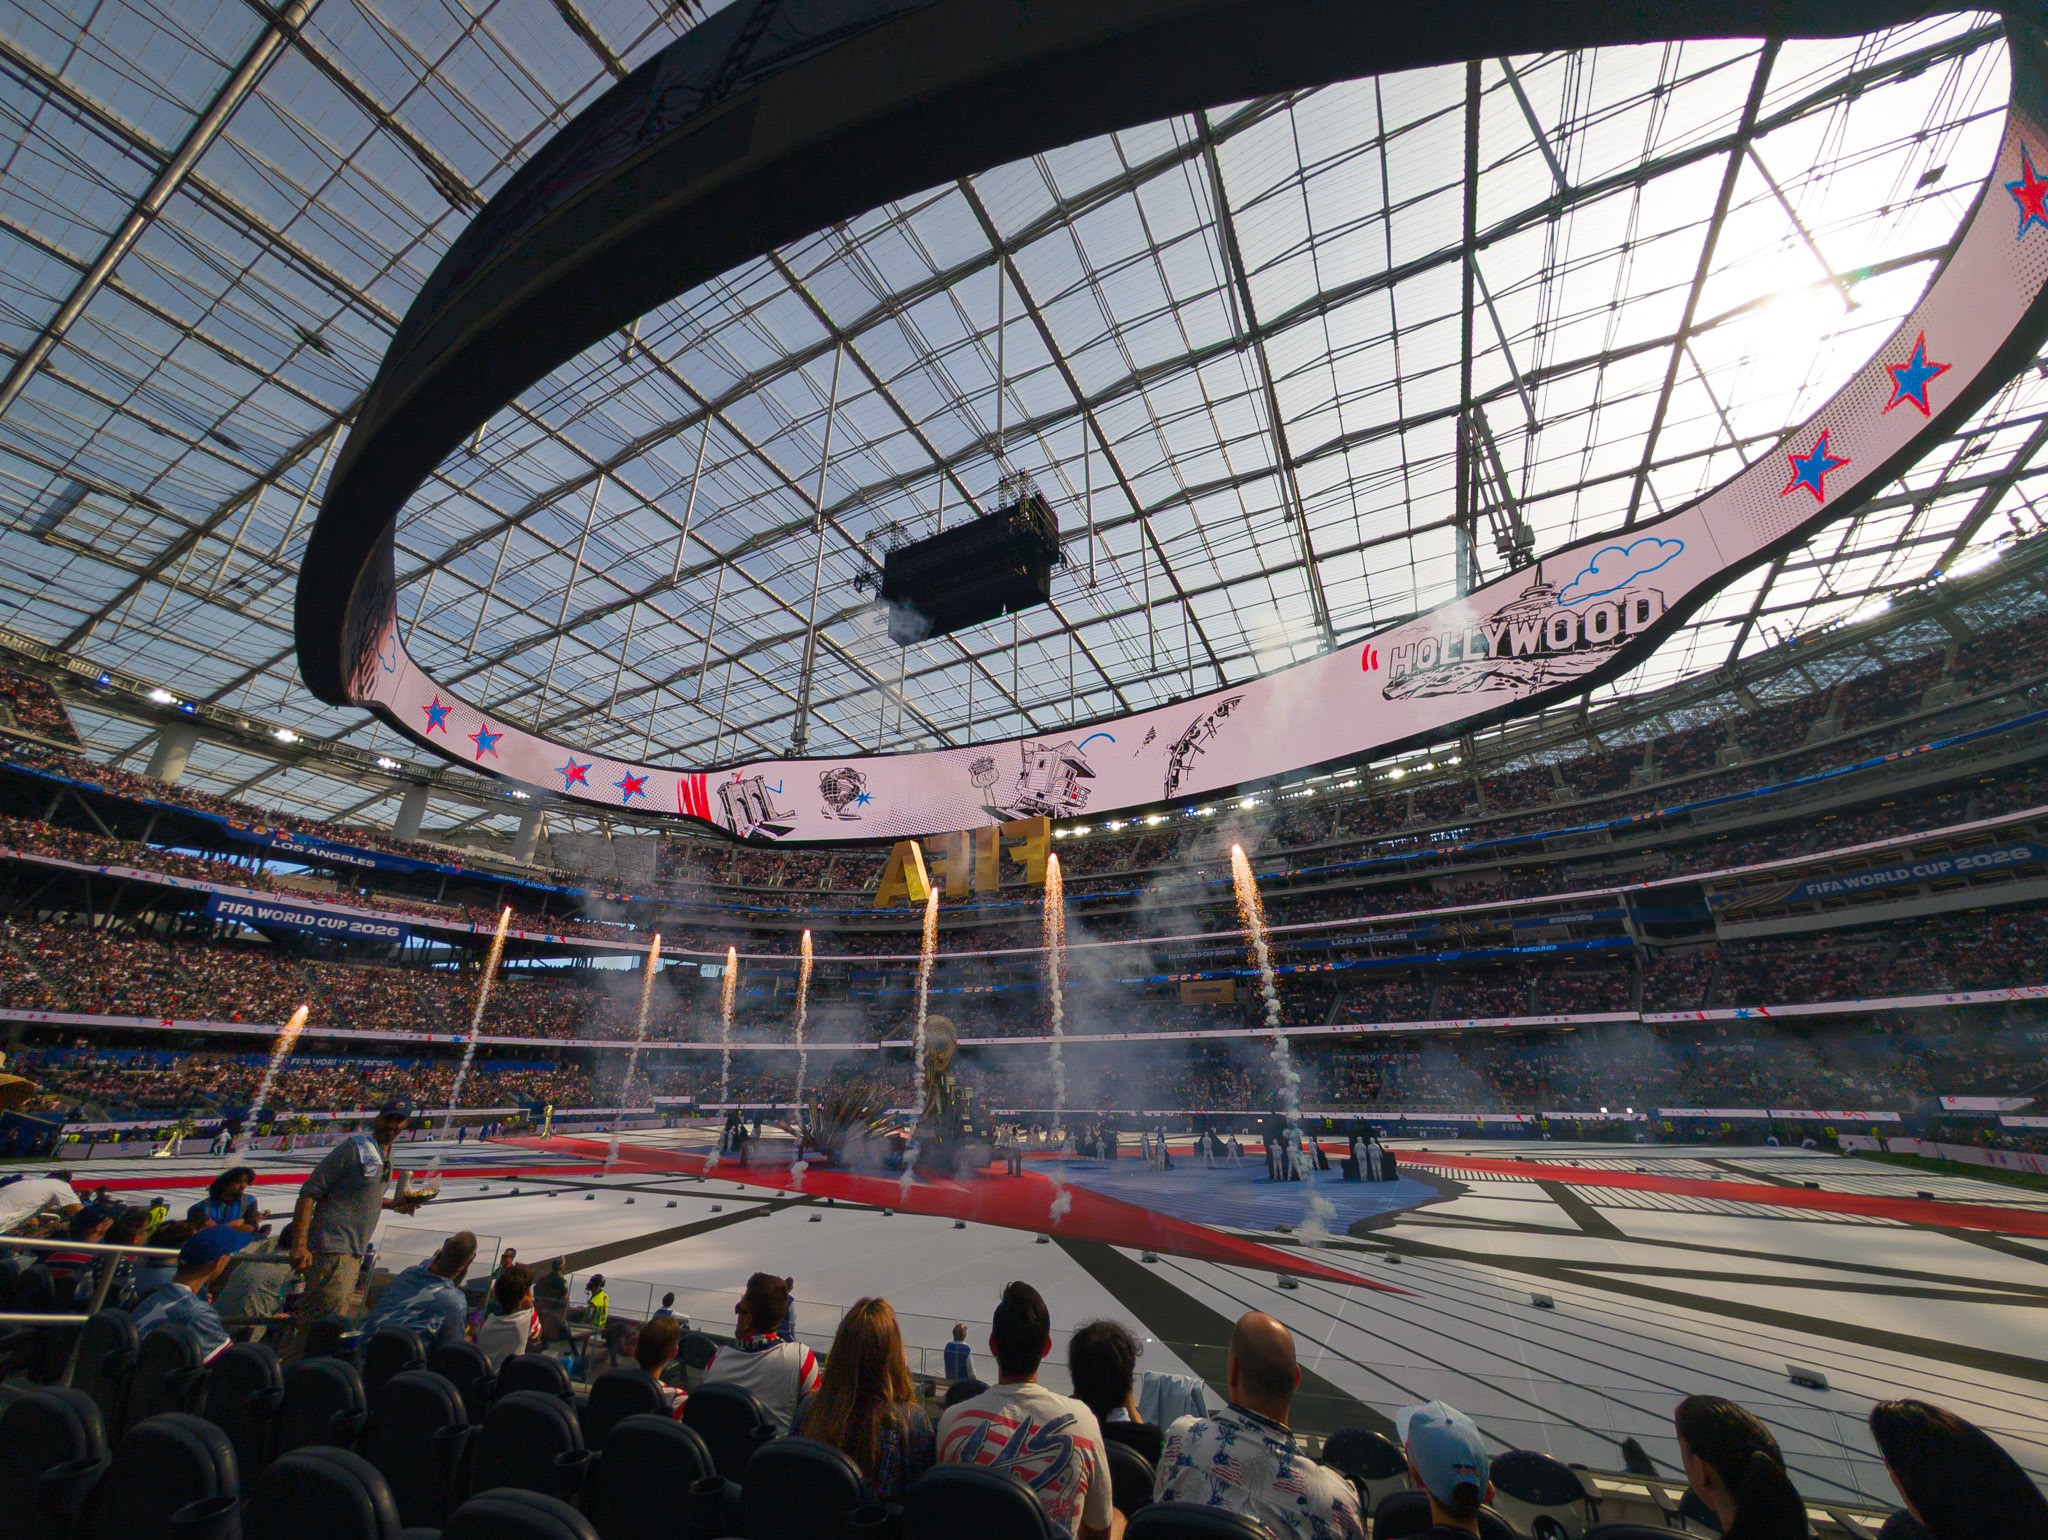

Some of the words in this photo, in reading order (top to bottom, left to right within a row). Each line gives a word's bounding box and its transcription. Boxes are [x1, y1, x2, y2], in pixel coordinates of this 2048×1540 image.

[1388, 587, 1664, 679] HOLLYWOOD
[271, 840, 305, 852] LOS
[307, 847, 377, 868] ANGELES
[1806, 881, 1844, 896] FIFA
[1843, 868, 1911, 889] WORLD
[1912, 860, 1952, 878] CUP
[1955, 847, 2033, 870] 2026
[217, 901, 255, 917] FIFA
[257, 907, 316, 926] WORLD
[317, 916, 349, 930] CUP
[348, 921, 400, 937] 2026
[1354, 933, 1408, 943] ANGELES
[1181, 951, 1201, 959] WORLD
[1502, 1123, 1525, 1132] FIFA
